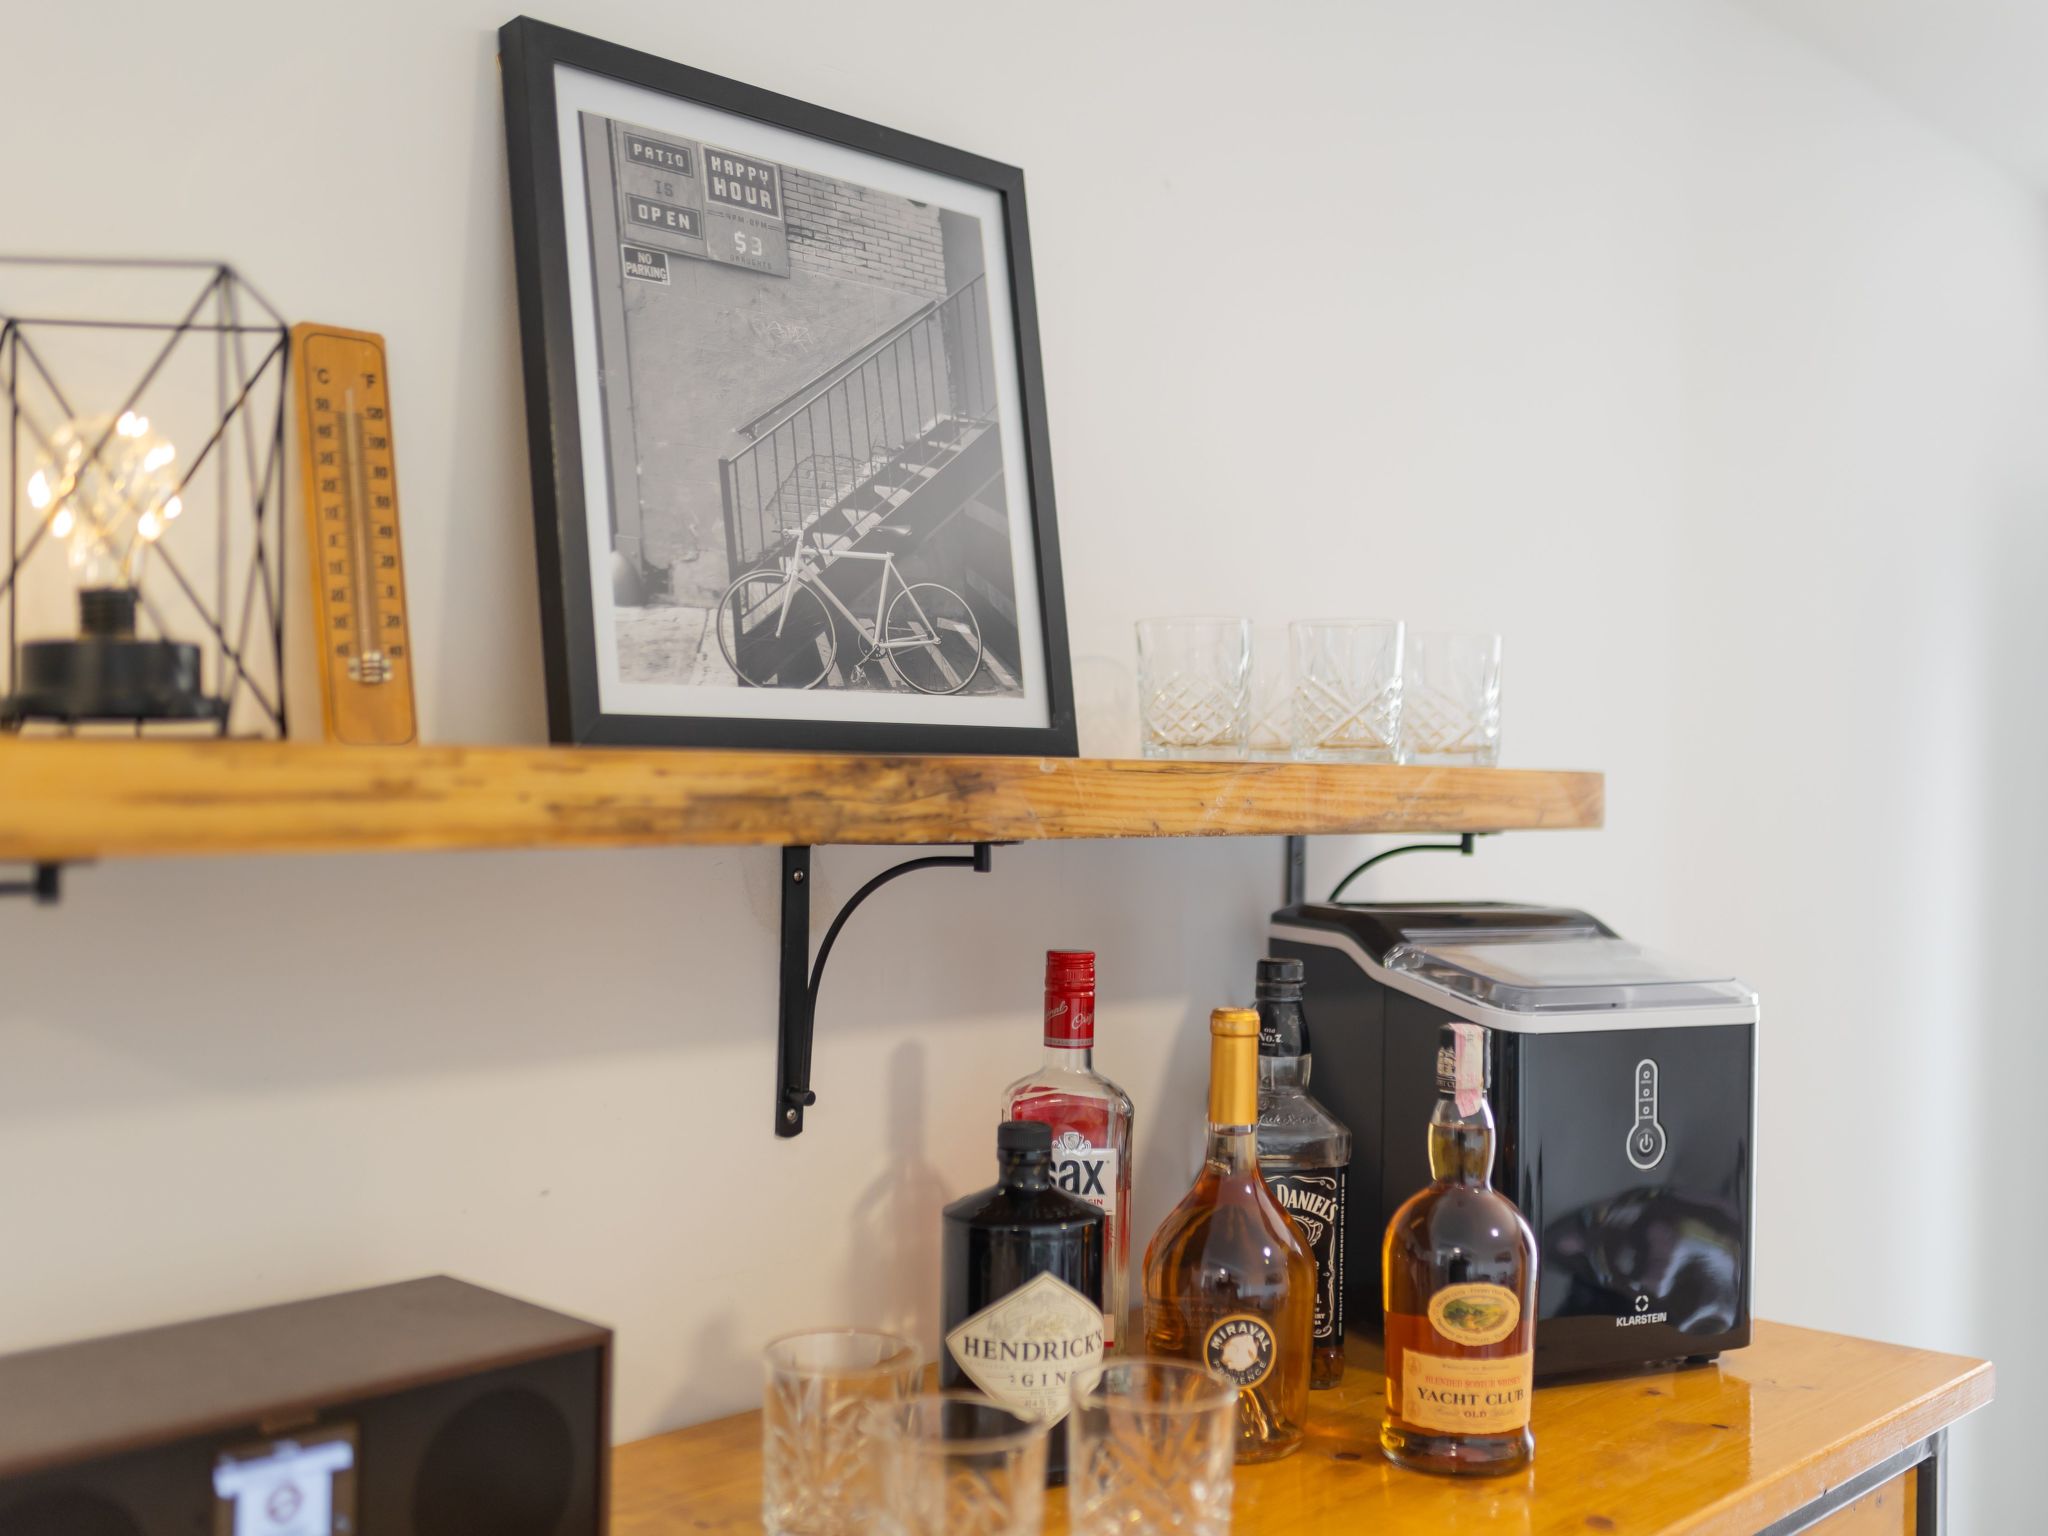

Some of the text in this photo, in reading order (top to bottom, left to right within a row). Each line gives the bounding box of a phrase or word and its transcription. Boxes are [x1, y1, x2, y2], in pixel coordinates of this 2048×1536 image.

[633, 143, 684, 167] PATIO
[711, 155, 769, 185] HAPPY
[653, 179, 674, 197] IS
[713, 177, 773, 210] HOUR
[637, 204, 691, 230] OPEN
[734, 231, 762, 256] $3
[637, 251, 652, 265] NO
[625, 262, 667, 280] PARKING
[1276, 1183, 1339, 1222] DANIEL'S
[1616, 1312, 1667, 1327] KLARSTEIN
[963, 1329, 1102, 1363] HENDRICK'S
[1210, 1321, 1270, 1352] MIRAVAL
[1021, 1371, 1067, 1388] GIN
[1424, 1375, 1463, 1388] BLENDED
[1417, 1386, 1524, 1406] YACHT CLUB
